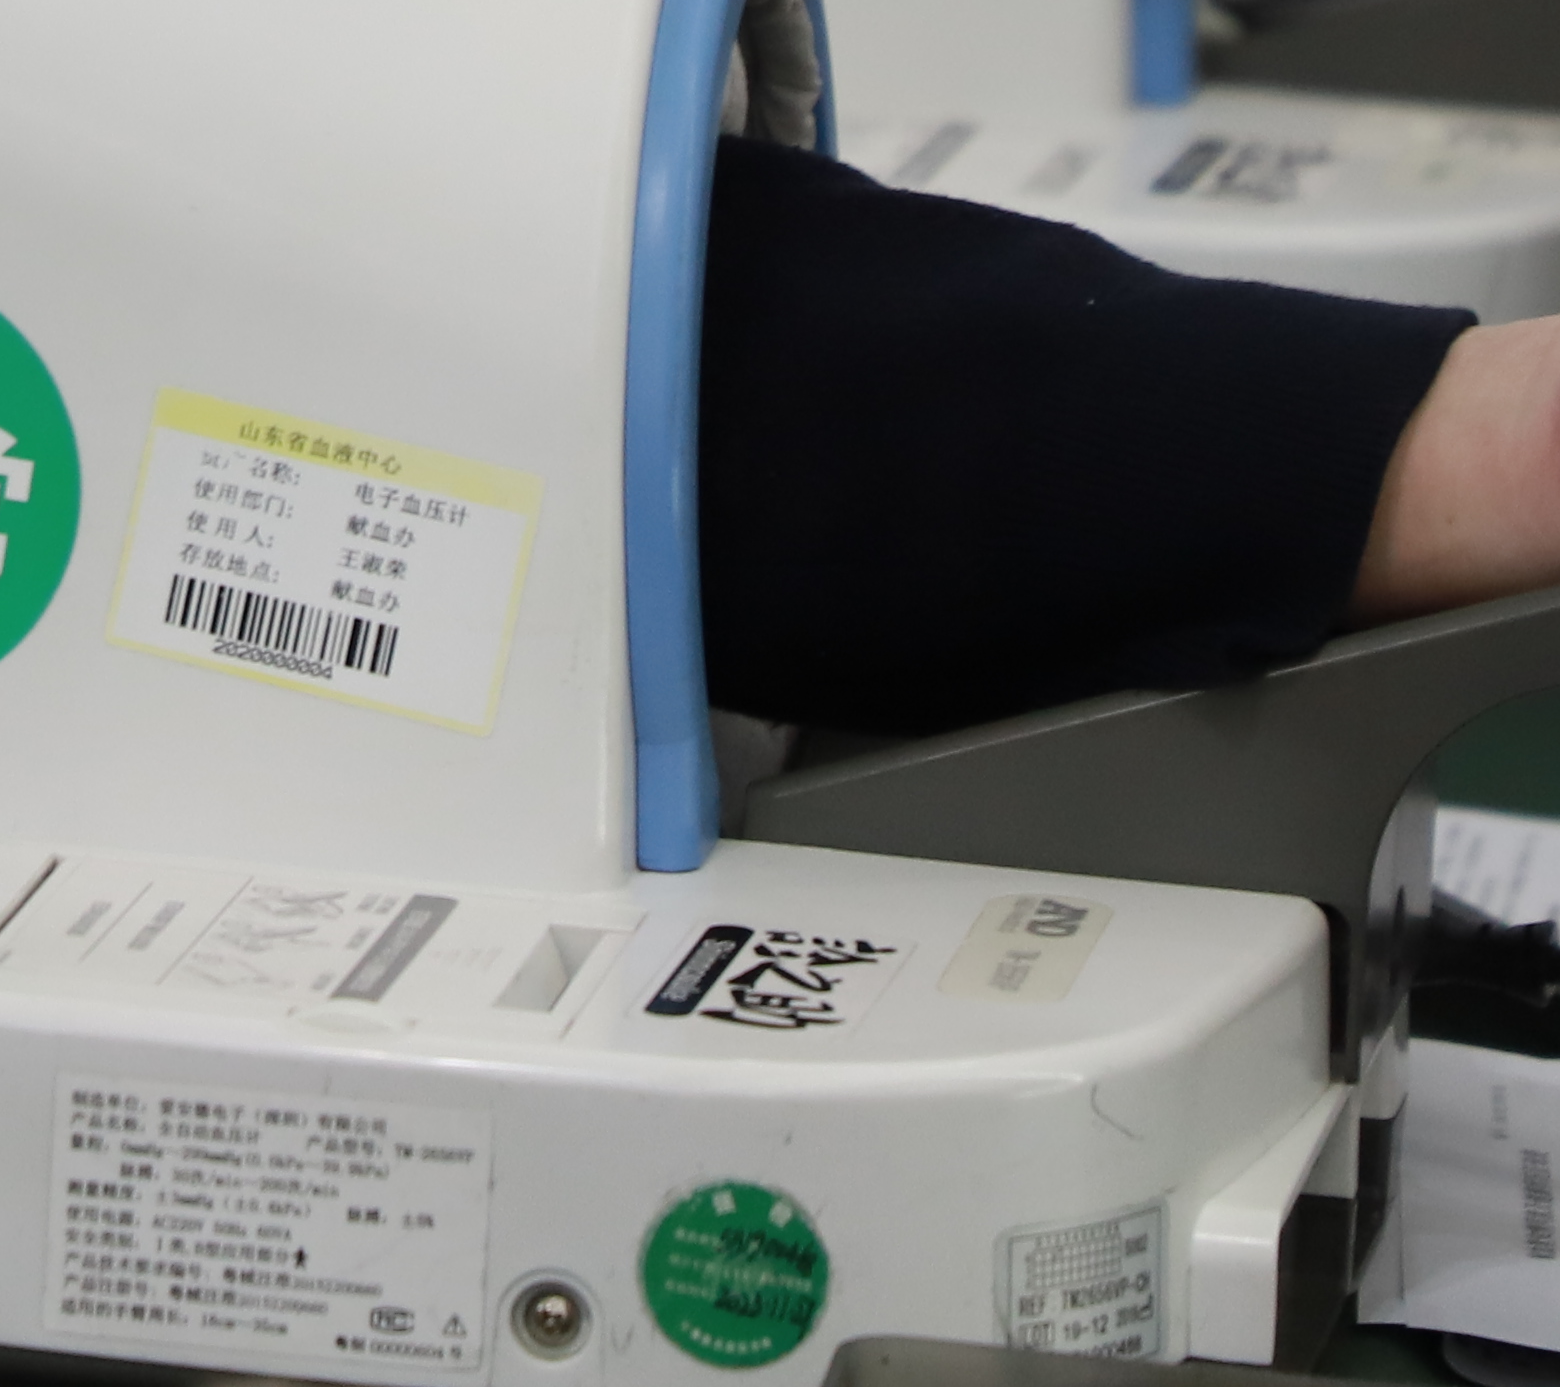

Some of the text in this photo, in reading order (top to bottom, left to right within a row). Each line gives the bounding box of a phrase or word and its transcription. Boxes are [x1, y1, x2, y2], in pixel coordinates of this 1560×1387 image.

[239, 421, 403, 475] 山东省血液中心
[194, 478, 416, 549] 使用部门: 献血办
[355, 482, 470, 527] 电子血压计
[180, 543, 400, 613] 存放地点: 献血办
[213, 639, 333, 679] 2020000004
